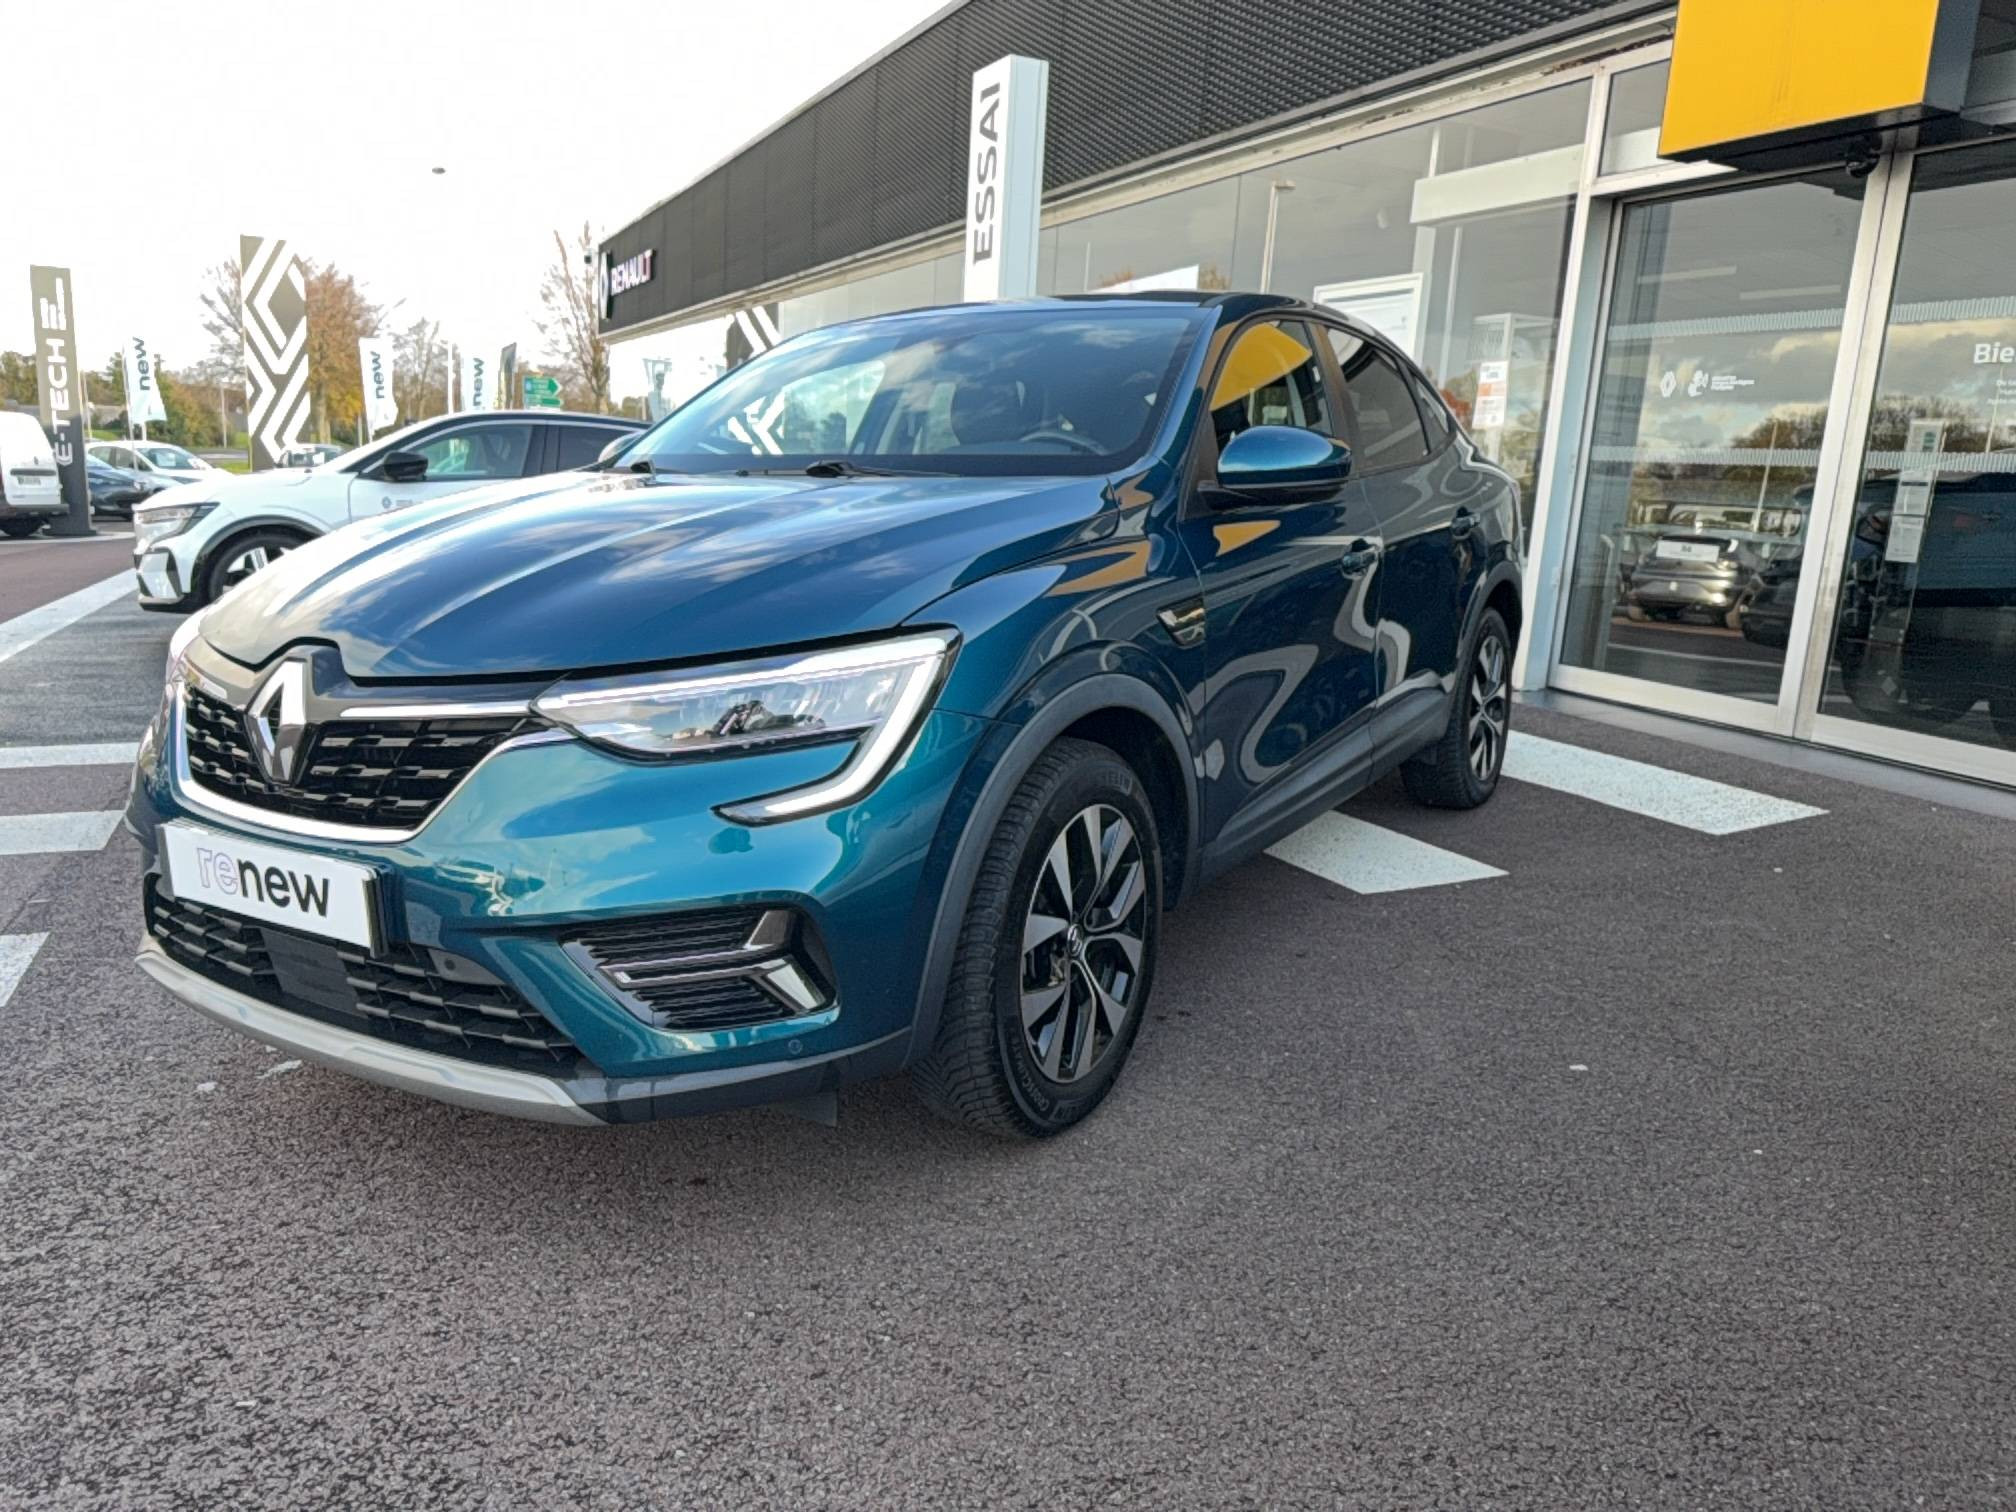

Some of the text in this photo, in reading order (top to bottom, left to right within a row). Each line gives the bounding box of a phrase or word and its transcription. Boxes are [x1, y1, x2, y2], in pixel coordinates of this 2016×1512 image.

[973, 82, 1001, 265] ESSAI
[611, 249, 653, 296] RENAULT
[45, 337, 73, 466] E-TECH
[197, 847, 330, 918] renew
